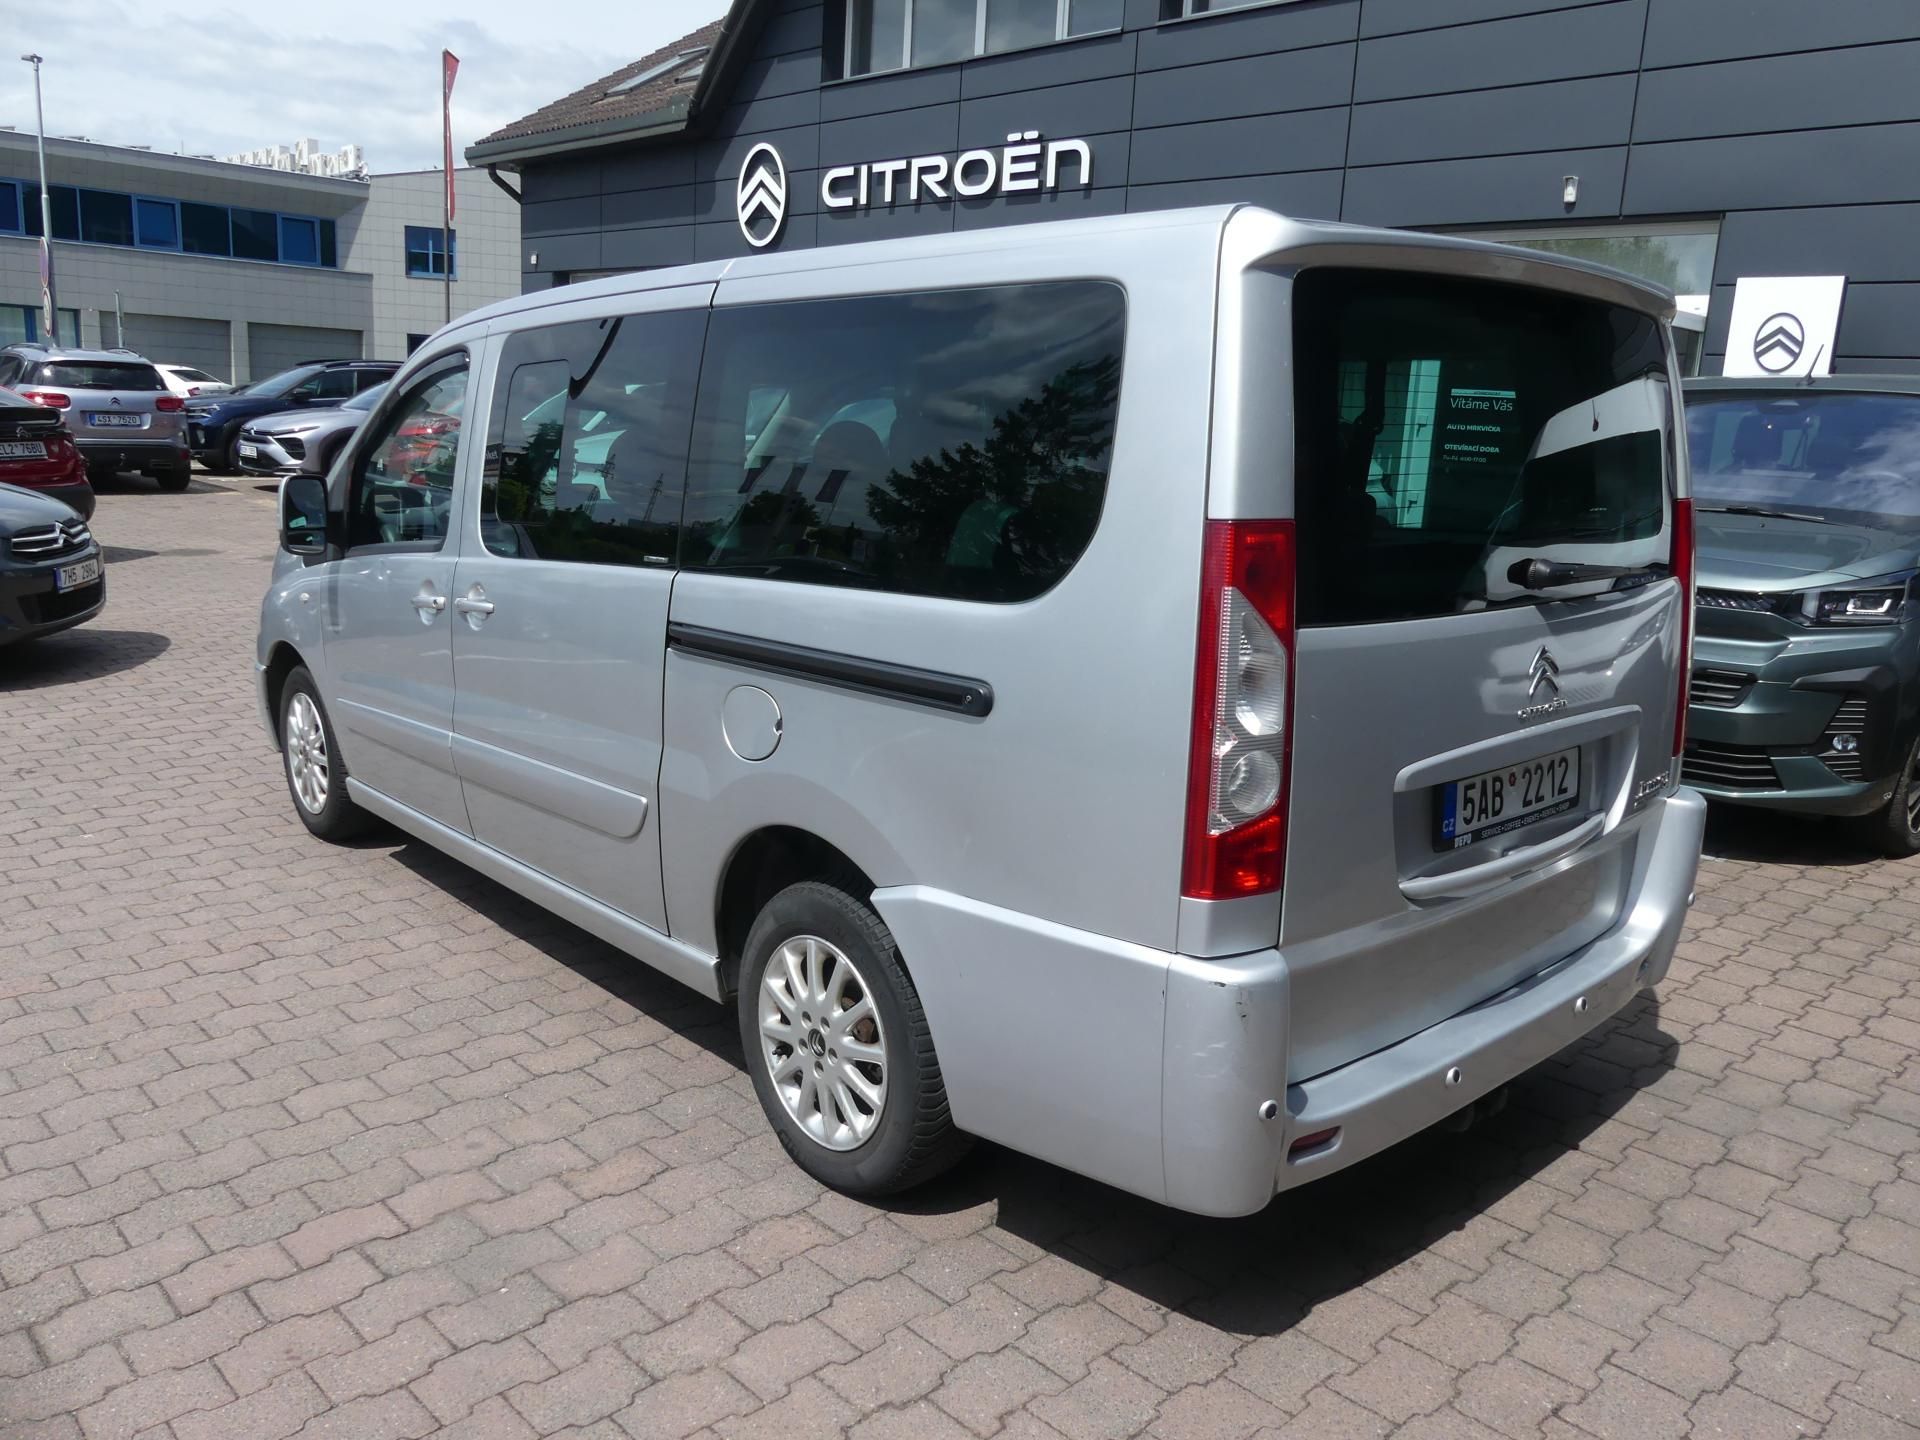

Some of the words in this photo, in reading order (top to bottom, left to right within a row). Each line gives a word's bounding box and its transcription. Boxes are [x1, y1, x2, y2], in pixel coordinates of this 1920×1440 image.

[821, 130, 1091, 208] CITROËN
[1492, 400, 1513, 412] Vás
[1462, 776, 1504, 826] 5AB
[1522, 757, 1569, 809] 2212
[1442, 818, 1455, 833] CZ
